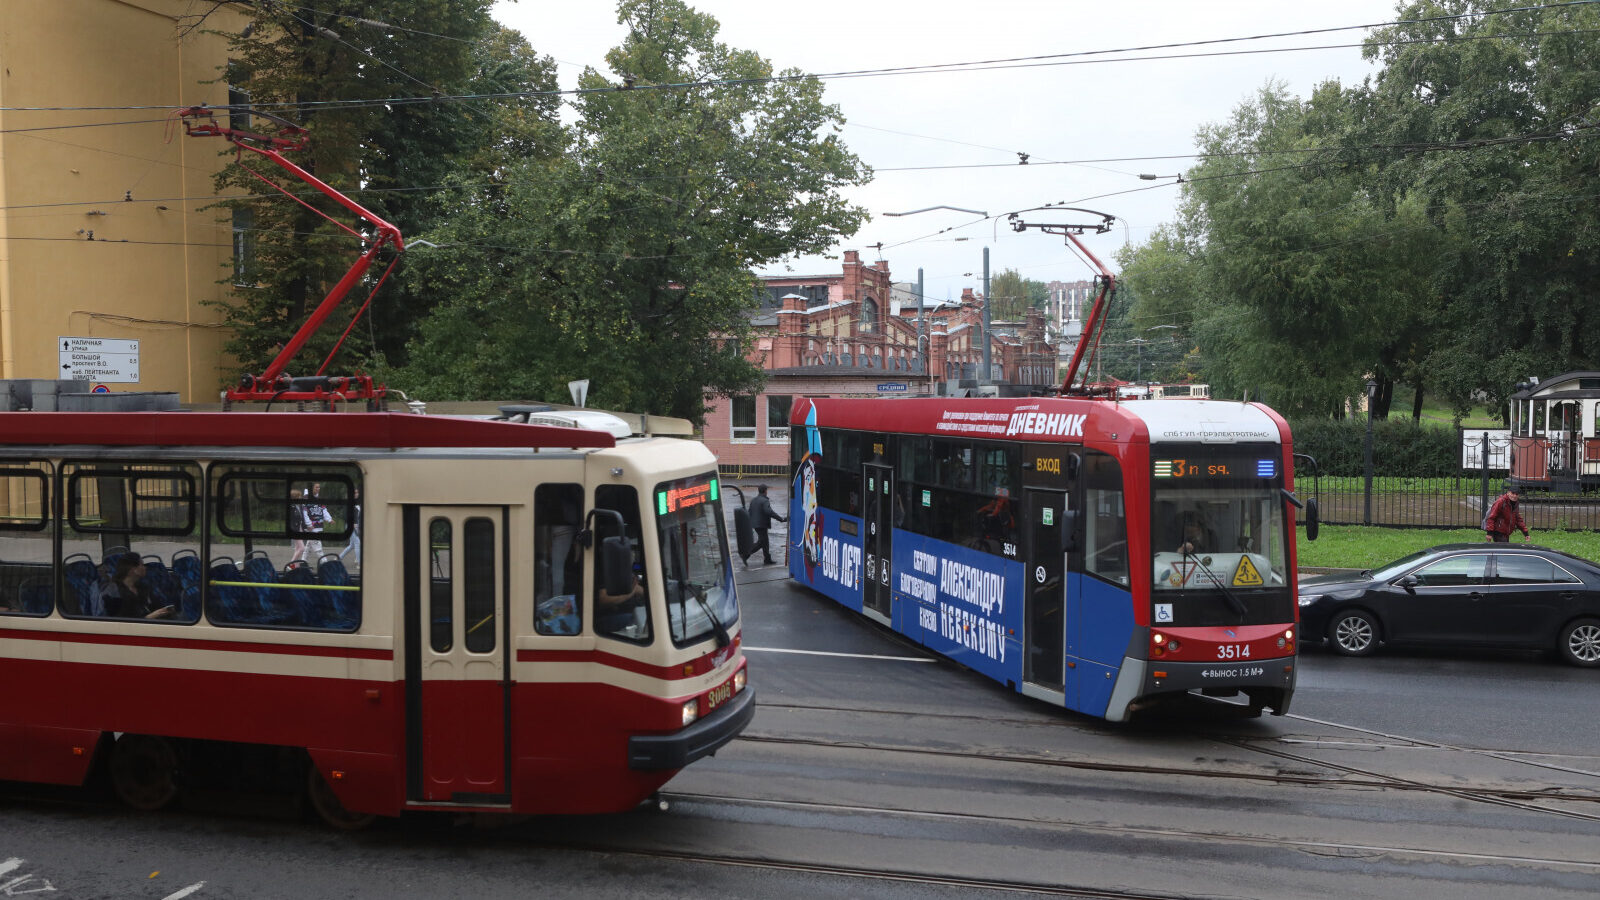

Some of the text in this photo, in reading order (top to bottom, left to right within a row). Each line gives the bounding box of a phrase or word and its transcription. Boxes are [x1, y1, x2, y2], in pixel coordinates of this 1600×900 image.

[1006, 412, 1087, 437] ДНЕВНИК
[1036, 457, 1061, 475] ВХОД
[1172, 459, 1186, 477] 3
[1207, 465, 1230, 475] sq.
[1003, 542, 1017, 556] 3514
[822, 535, 861, 591] 800 ЛЕТ
[940, 558, 1005, 617] АЛЕКСАНДРУ
[940, 602, 1005, 663] НЕВСКОМУ
[1216, 644, 1251, 659] 3514
[1209, 669, 1238, 678] ВЫНОС
